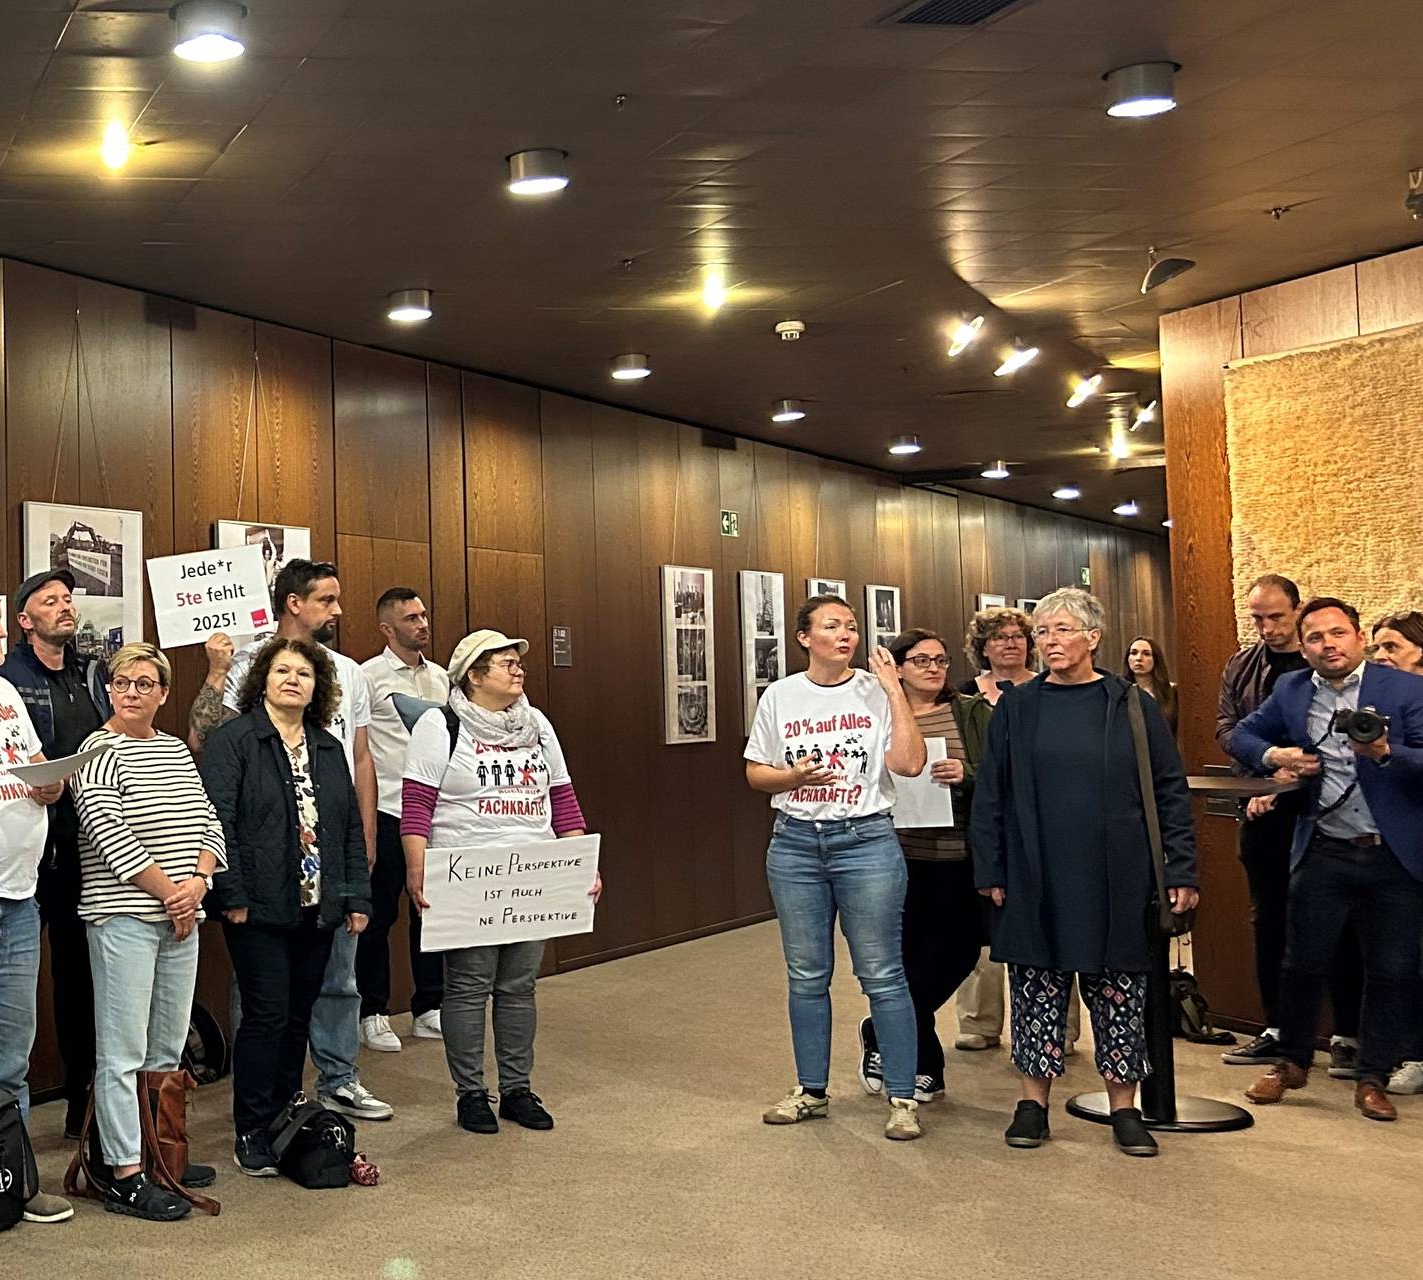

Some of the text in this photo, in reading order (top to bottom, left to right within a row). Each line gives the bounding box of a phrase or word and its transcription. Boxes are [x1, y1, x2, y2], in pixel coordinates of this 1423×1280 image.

[176, 584, 246, 607] 5te fehlt
[192, 612, 237, 632] 2025!
[815, 716, 838, 734] auf
[839, 713, 872, 731] Alles
